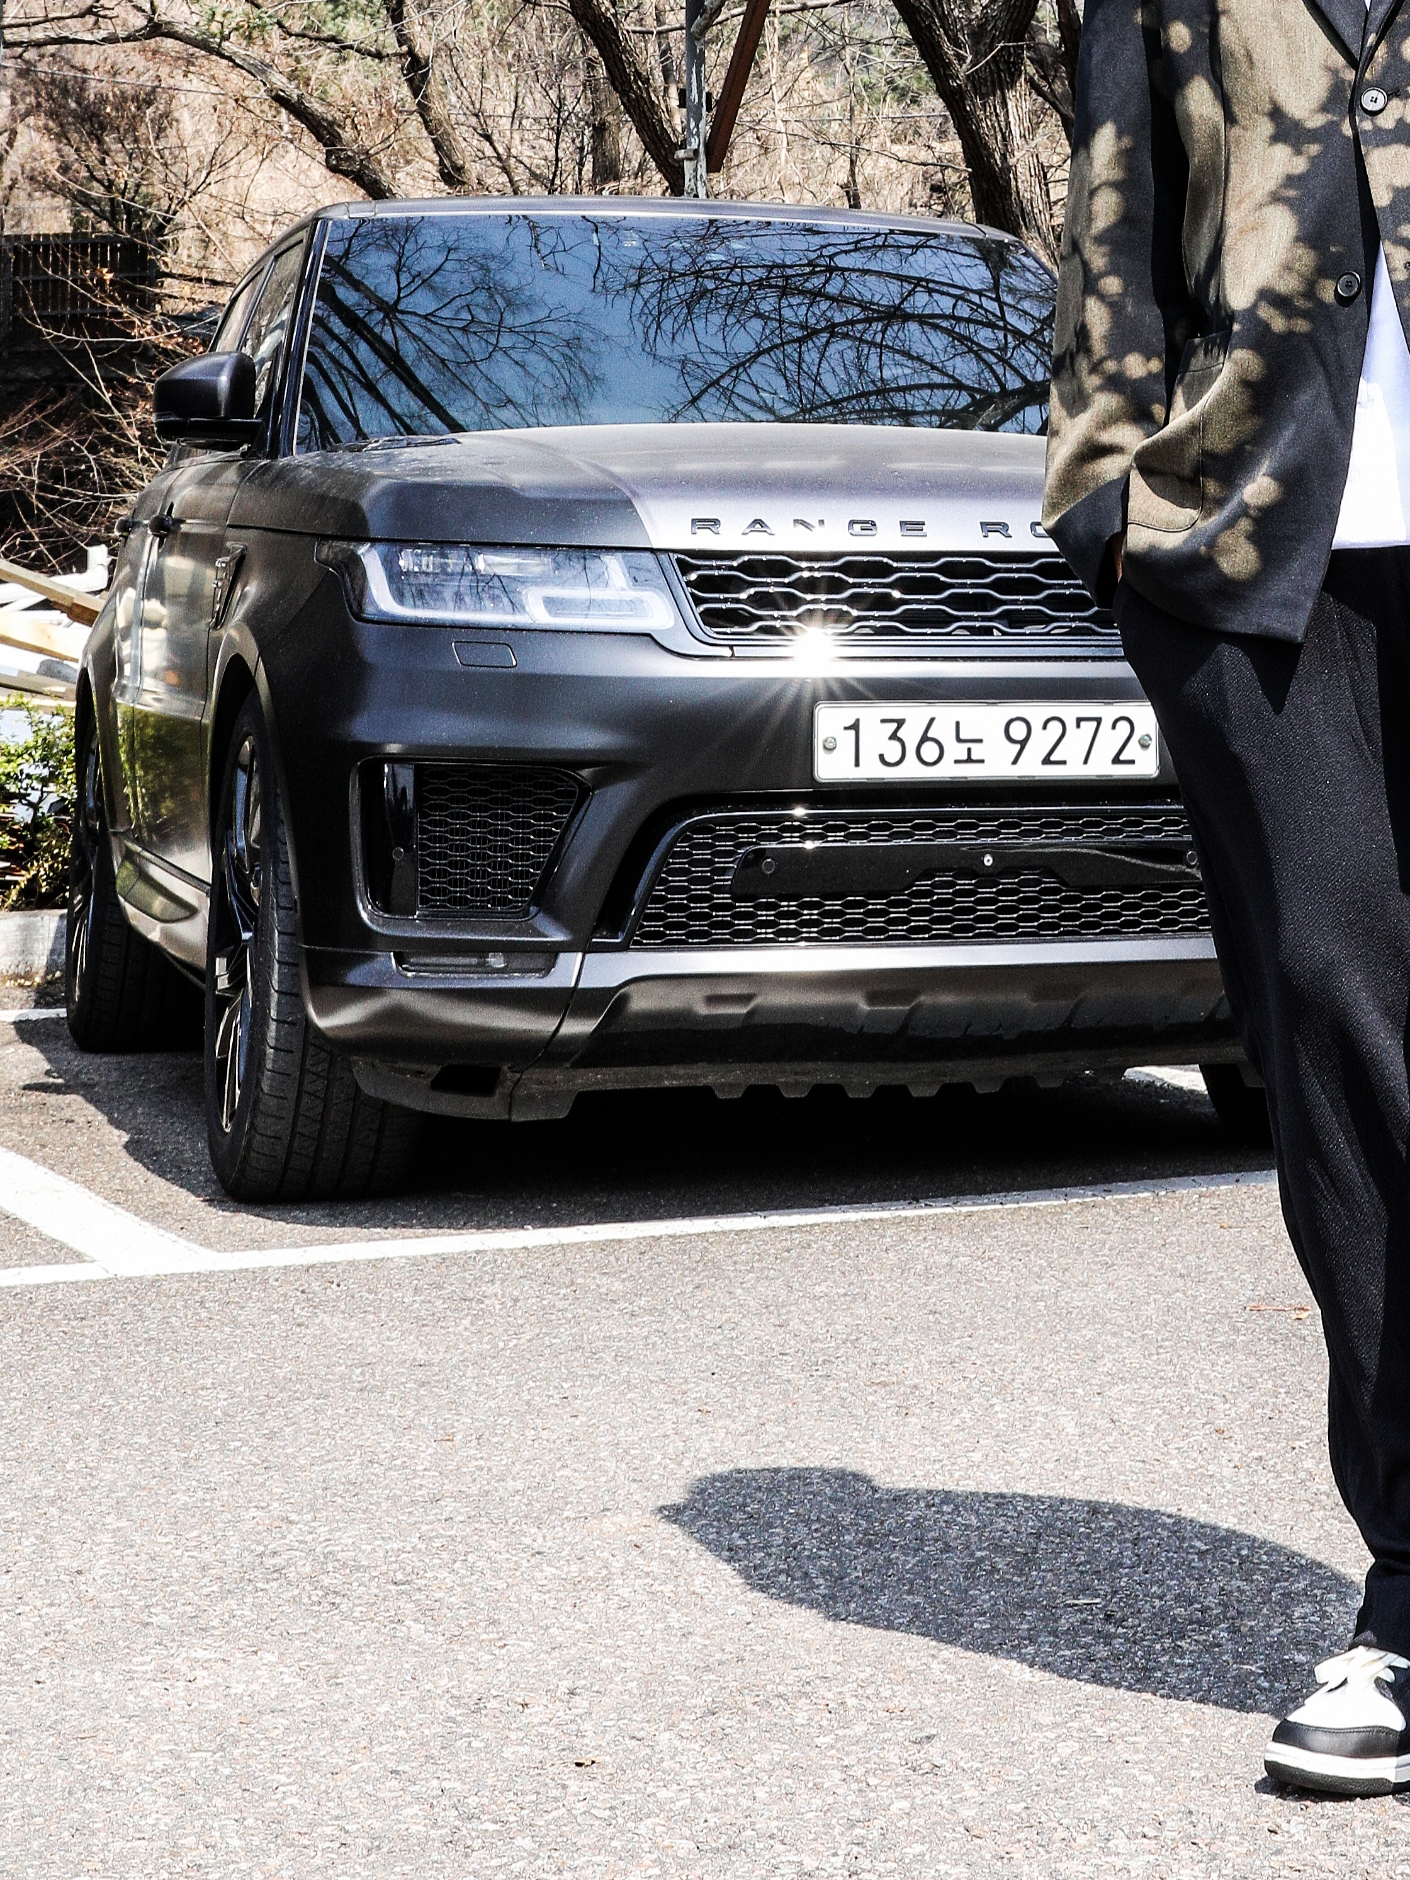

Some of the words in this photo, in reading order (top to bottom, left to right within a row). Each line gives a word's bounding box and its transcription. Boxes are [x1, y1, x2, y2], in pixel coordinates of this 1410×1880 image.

[690, 517, 928, 538] RANGE
[843, 717, 985, 768] 136노
[1003, 715, 1136, 766] 9272
